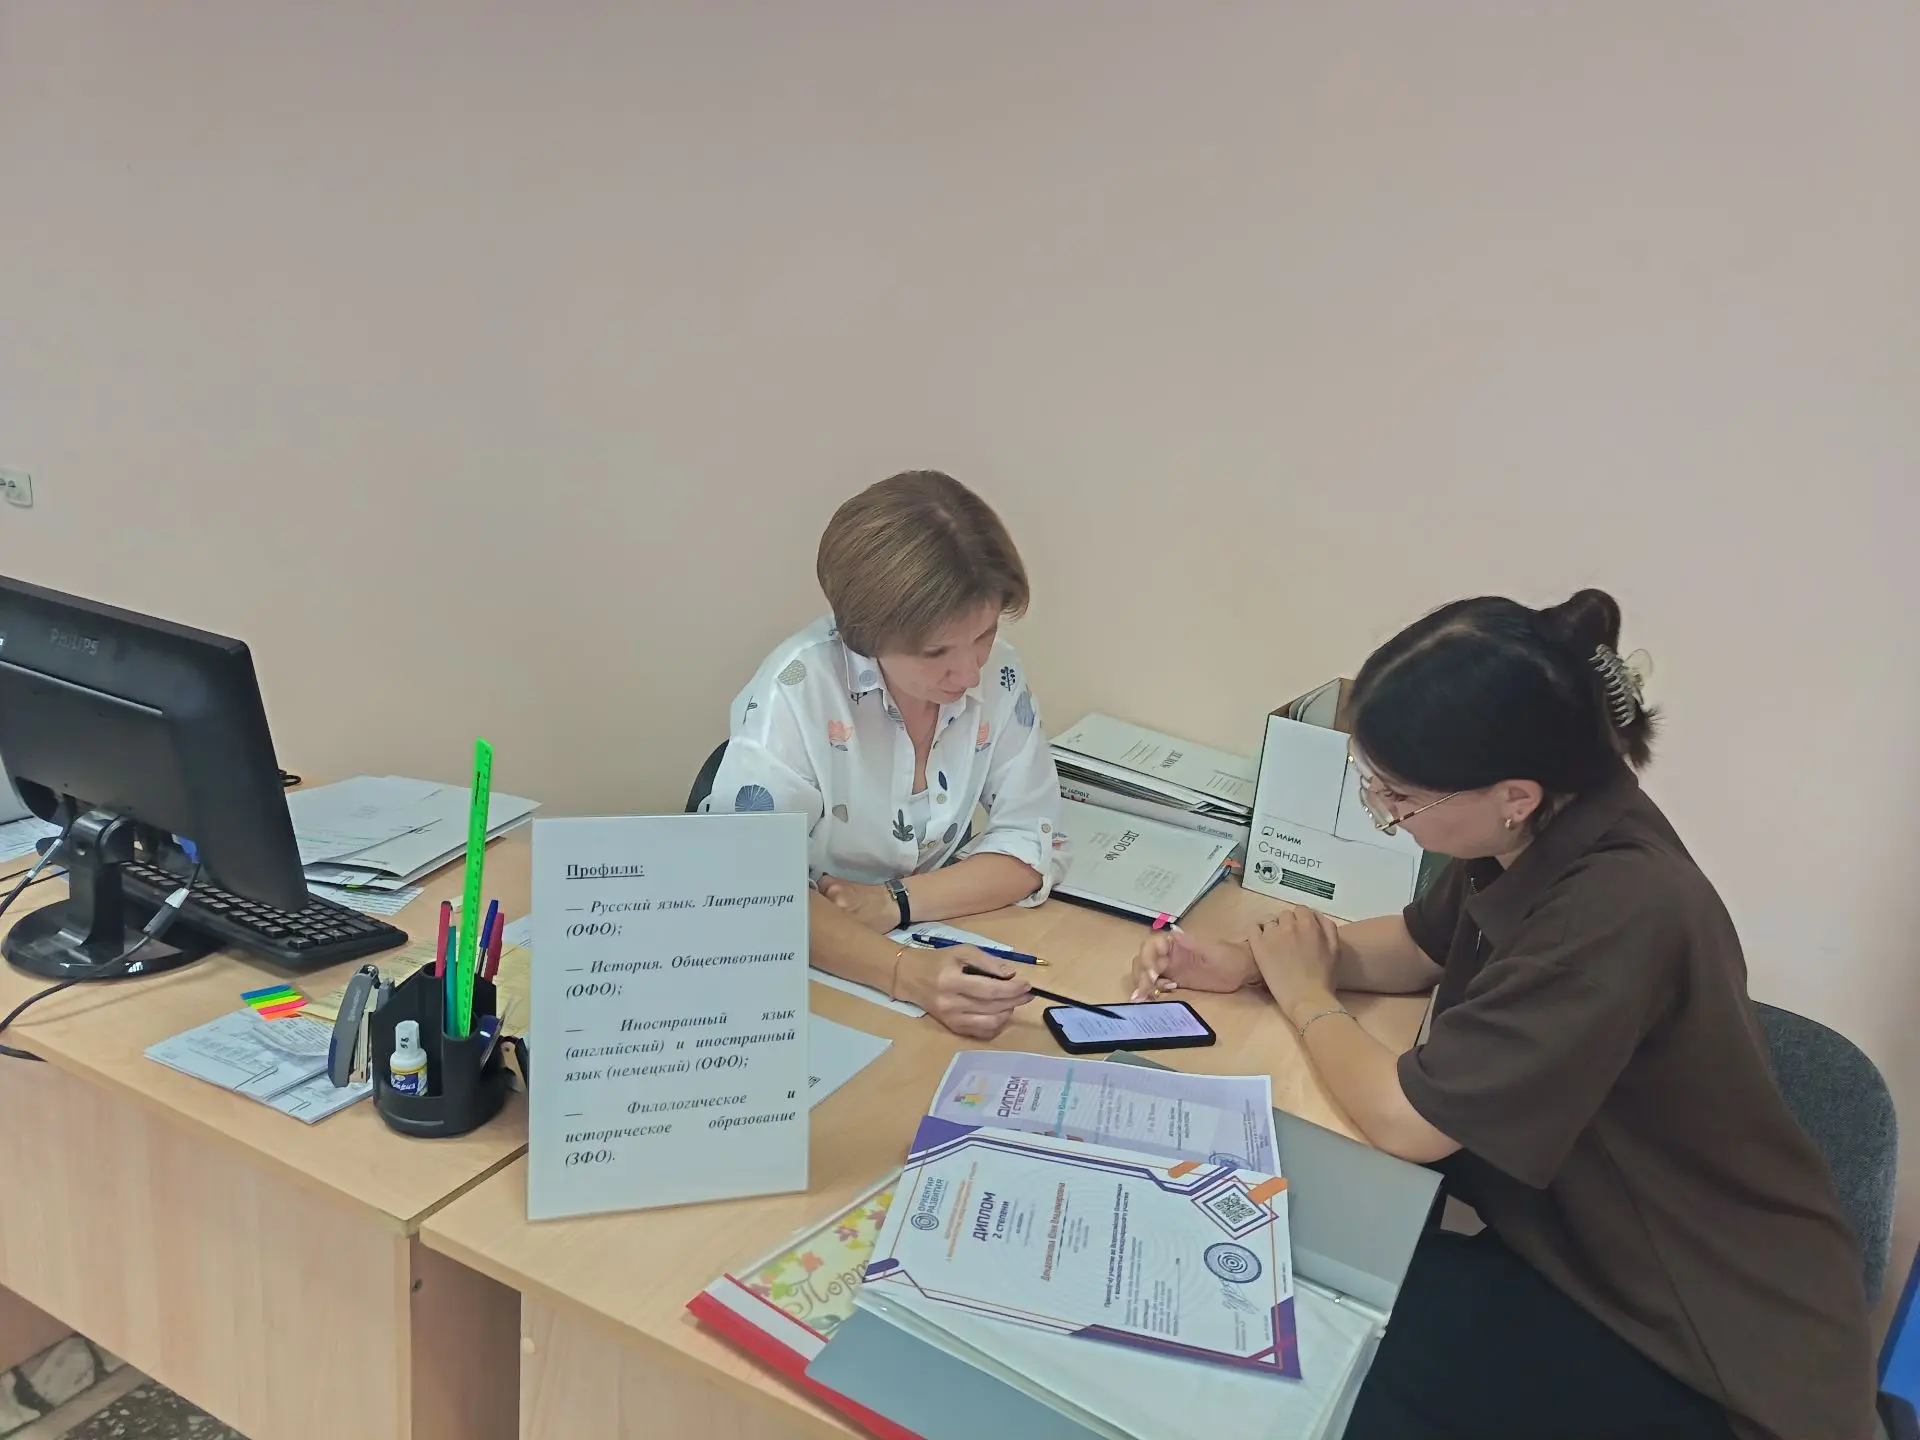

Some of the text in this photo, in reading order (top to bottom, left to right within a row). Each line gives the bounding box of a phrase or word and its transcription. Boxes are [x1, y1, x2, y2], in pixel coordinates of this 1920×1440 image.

[1113, 830, 1140, 852] ДЕЛО
[1258, 841, 1323, 869] Стандарт
[1104, 850, 1120, 861] №
[565, 862, 645, 880] Профили:
[590, 899, 651, 916] Русский
[656, 900, 696, 913] язык.
[702, 893, 794, 909] Литература
[566, 920, 622, 939] (ОФО);
[590, 959, 662, 975] История.
[671, 950, 796, 968] Обществознание
[566, 982, 622, 1000] (ОФО);
[620, 1012, 728, 1032] Иностранный
[761, 1008, 795, 1023] язык
[566, 1029, 796, 1060] (английский) и иностранный
[564, 1054, 750, 1083] язык (немецкий) (ОФО);
[627, 1093, 748, 1116] Филологическое
[786, 1088, 796, 1100] и
[997, 1076, 1021, 1118] ДИПЛОМ
[1013, 1079, 1030, 1111] СТЕПЕНИ
[565, 1108, 796, 1145] историческое образование
[917, 1176, 934, 1212] ОРИЕНТИР
[926, 1179, 944, 1214] РАЗВИТИЯ
[973, 1191, 996, 1242] ДИПЛОМ
[992, 1201, 1010, 1240] 2 степени
